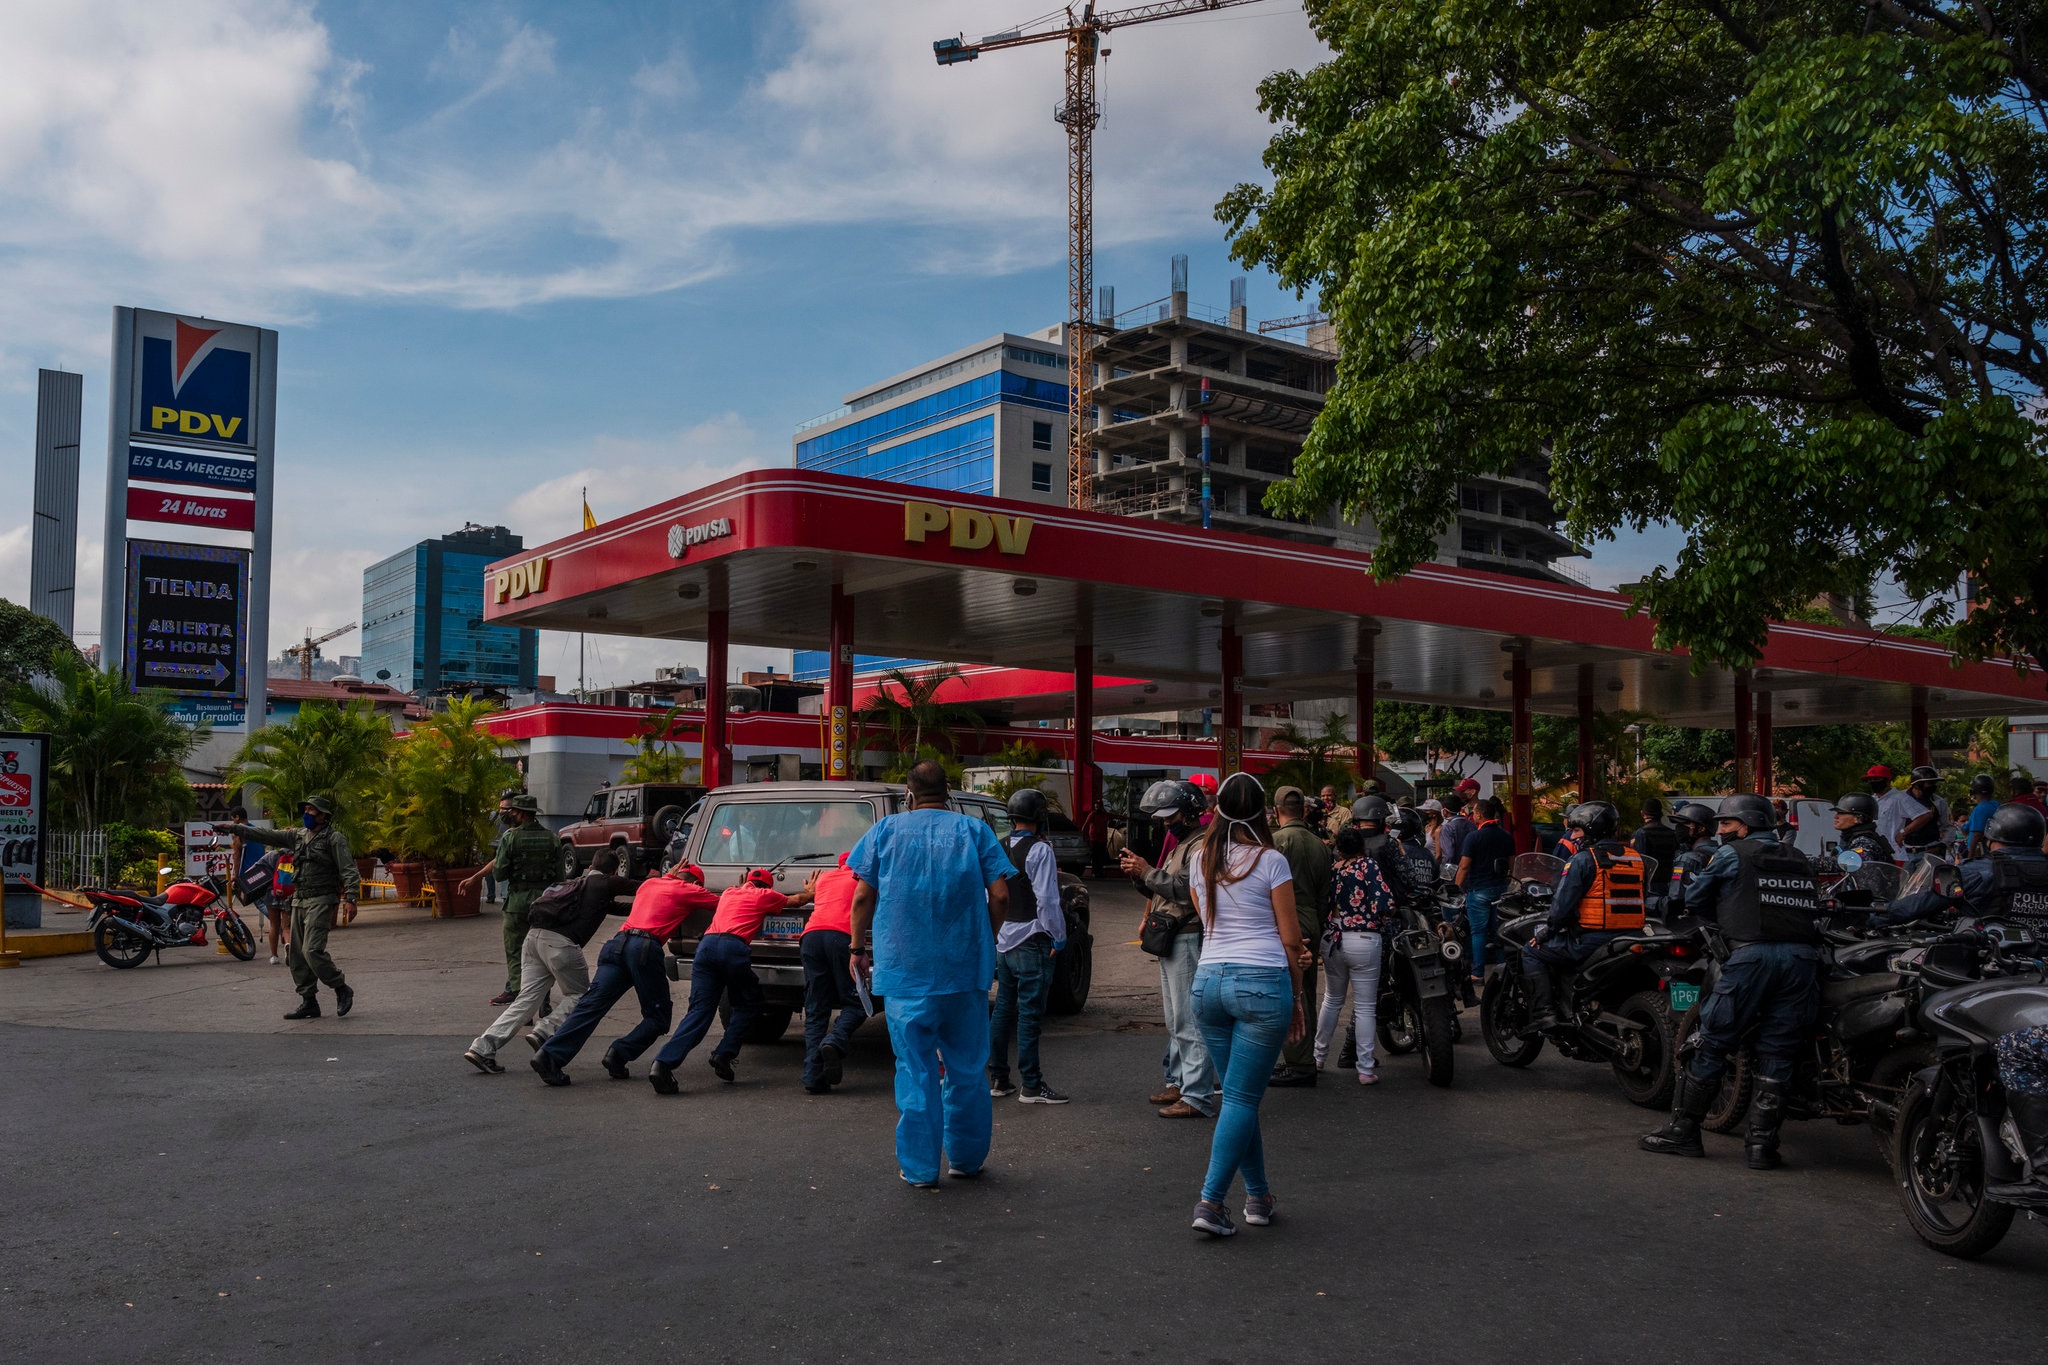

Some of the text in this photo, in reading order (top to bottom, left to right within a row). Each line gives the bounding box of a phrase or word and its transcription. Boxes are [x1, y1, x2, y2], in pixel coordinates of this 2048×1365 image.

[151, 405, 243, 438] PDV
[132, 456, 153, 467] E/S
[157, 458, 182, 471] LAS
[185, 461, 255, 479] MERCEDES
[159, 499, 227, 518] 24 Horas
[685, 517, 732, 545] PDVSA
[905, 500, 1035, 555] PDV
[144, 576, 233, 600] TIENDA
[494, 557, 548, 604] PDV
[147, 618, 233, 637] ABIERTA
[142, 638, 231, 655] 24 HORAS
[908, 837, 924, 849] AL
[1758, 878, 1815, 890] POLICIA
[1761, 893, 1817, 909] NACIONAL
